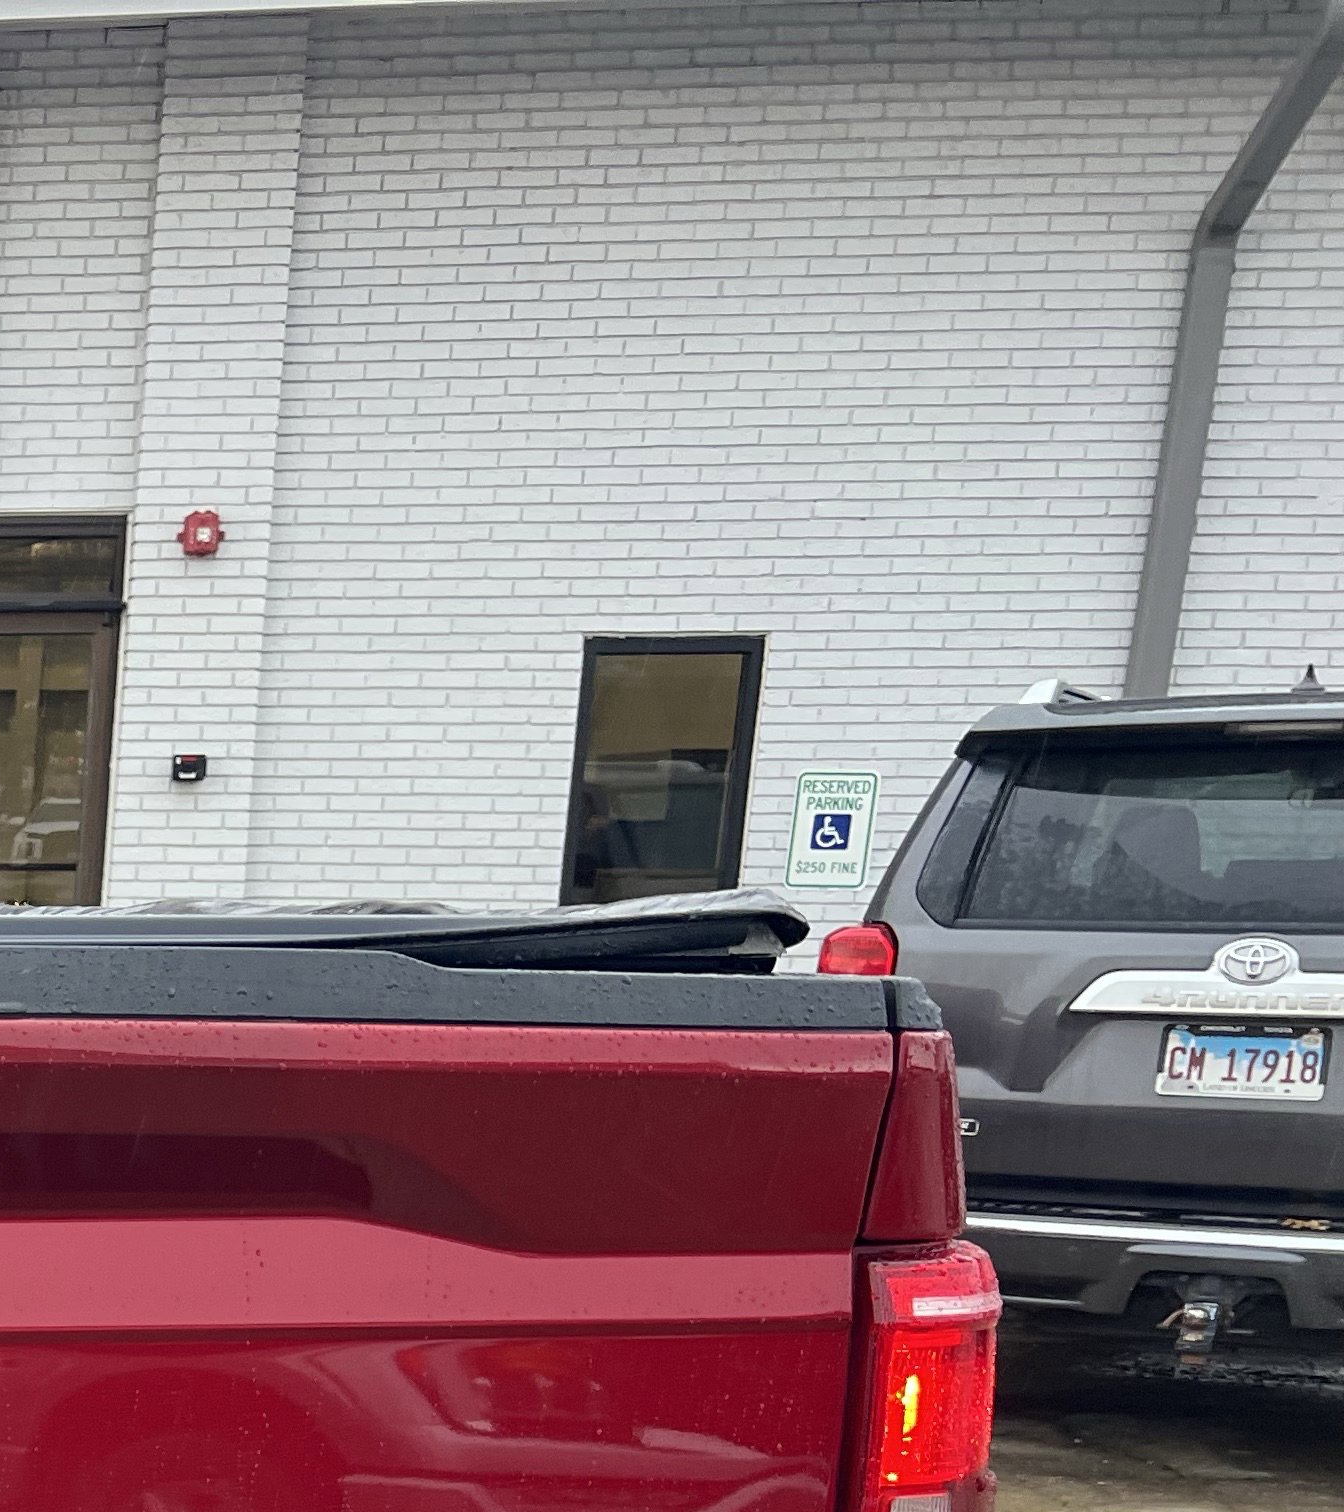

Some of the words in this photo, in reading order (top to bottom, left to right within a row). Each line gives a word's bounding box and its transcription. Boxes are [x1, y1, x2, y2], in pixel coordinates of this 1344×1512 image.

[802, 780, 872, 795] RESERVED
[806, 796, 864, 811] PARKING
[795, 860, 826, 874] $250
[831, 861, 858, 874] FINE
[1168, 1046, 1207, 1081] CM
[1221, 1048, 1319, 1083] 17918
